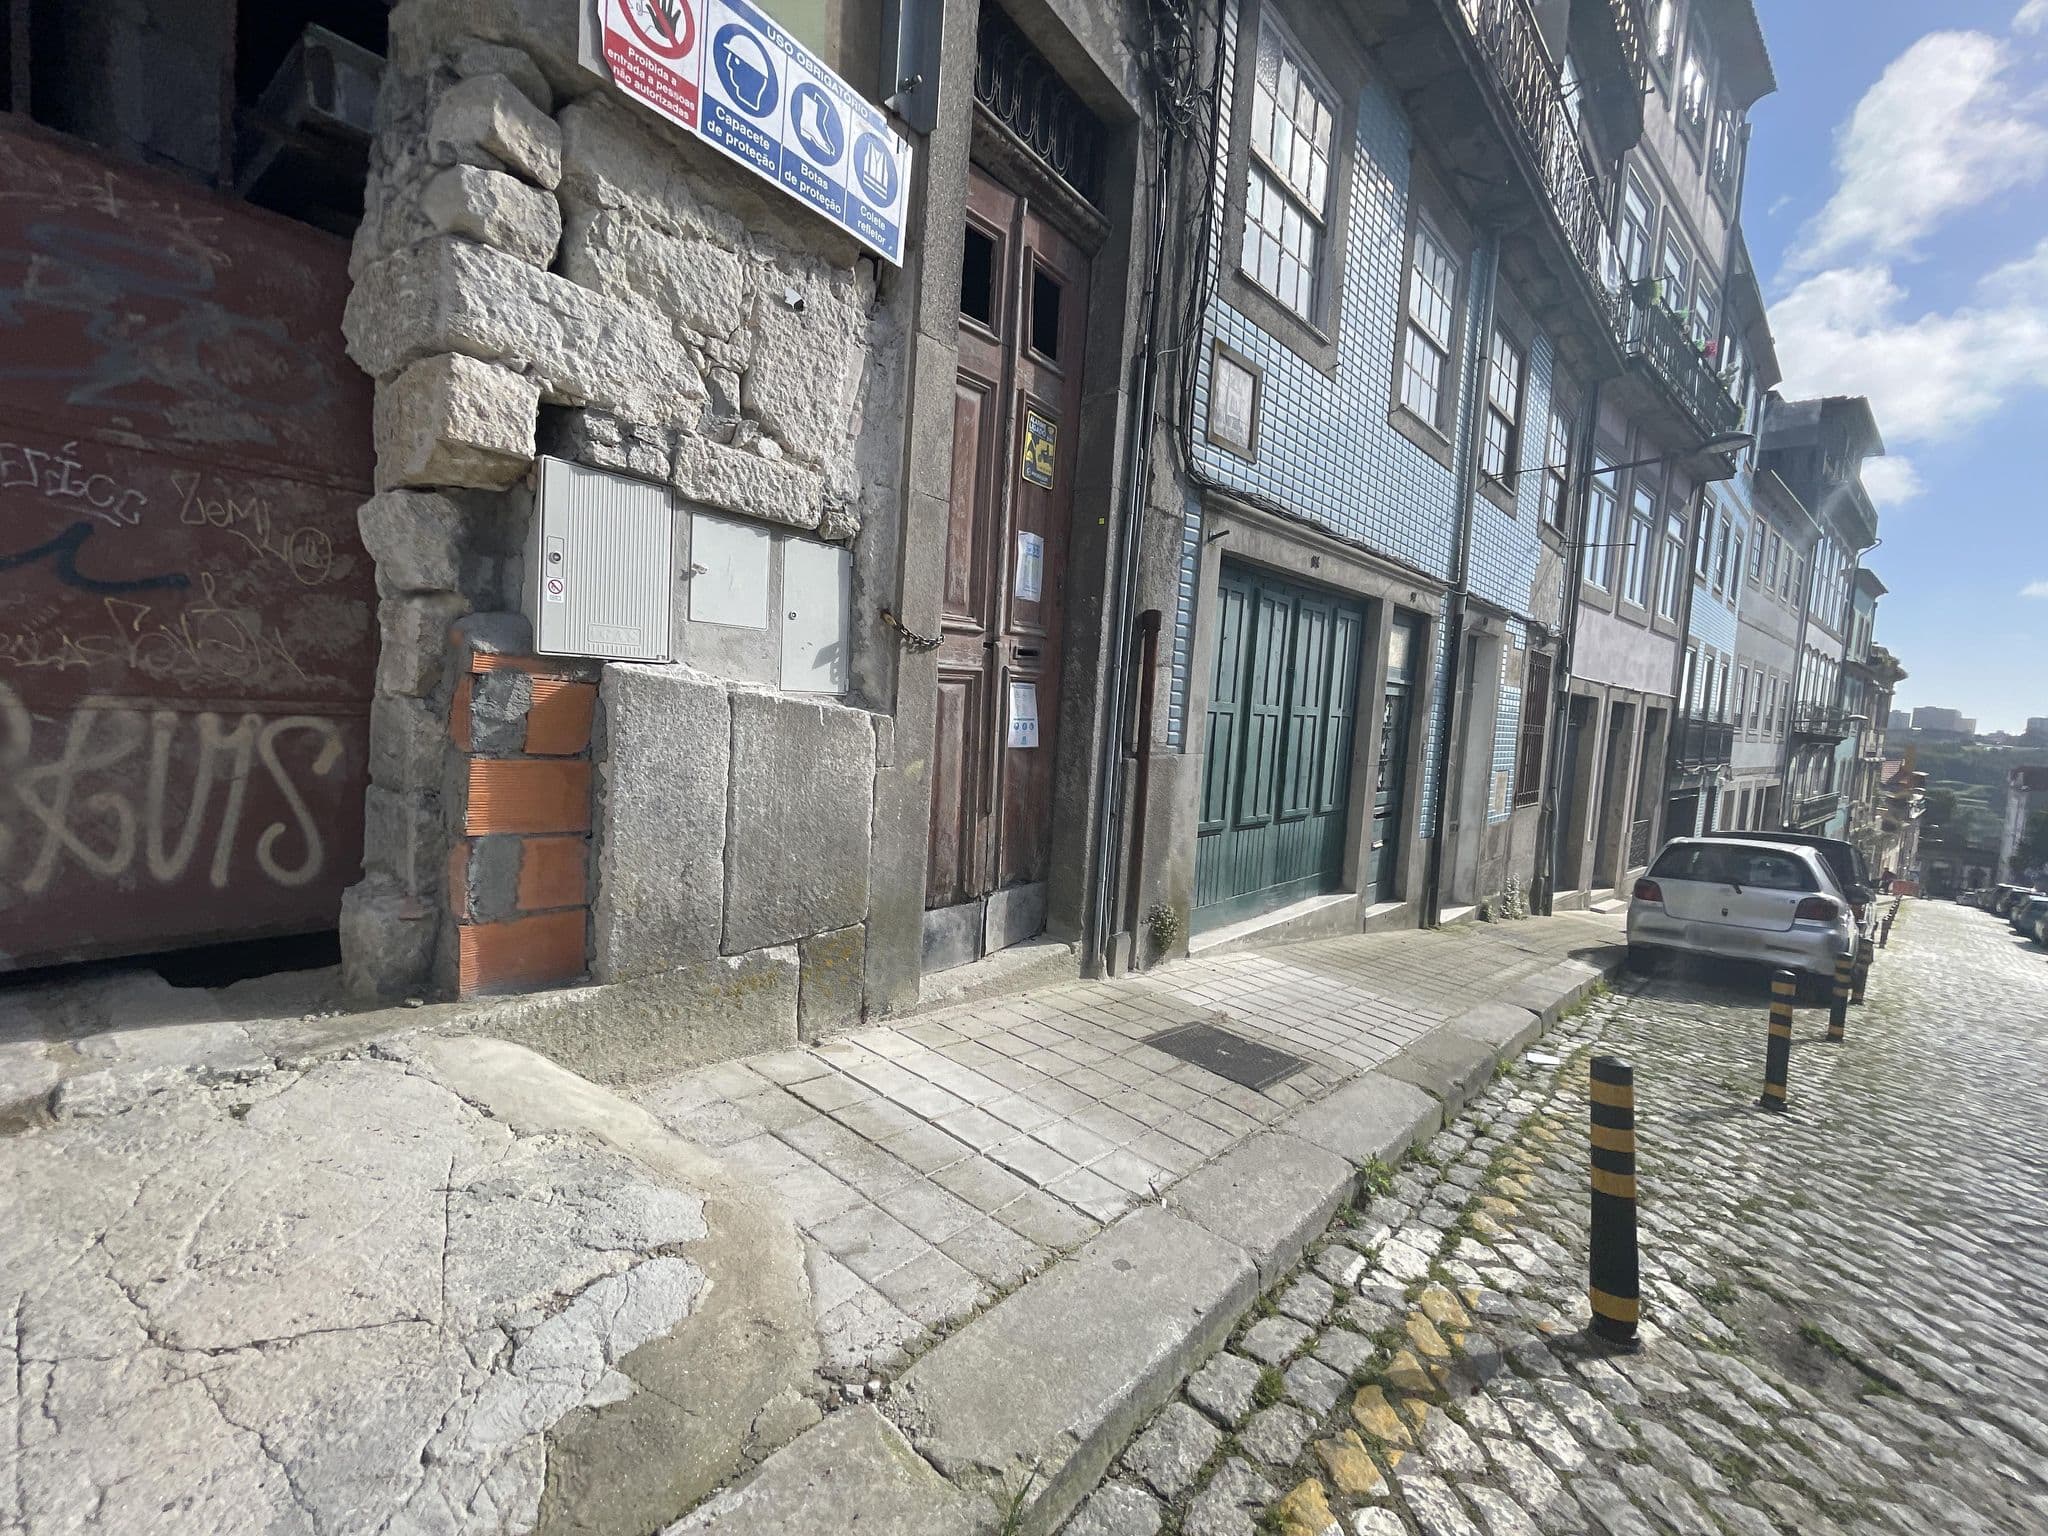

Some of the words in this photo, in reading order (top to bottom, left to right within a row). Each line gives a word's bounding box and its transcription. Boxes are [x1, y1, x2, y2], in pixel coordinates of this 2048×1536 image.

[767, 25, 794, 55] USO
[607, 48, 645, 78] entrada
[647, 75, 654, 84] a
[656, 80, 695, 111] pessoas
[628, 47, 669, 81] Proibida
[670, 77, 677, 86] a
[613, 65, 632, 84] não
[634, 80, 689, 120] autorizadas
[707, 120, 723, 137] de
[725, 132, 776, 171] proteção
[715, 106, 770, 150] Capacete
[784, 170, 798, 186] de
[800, 183, 842, 214] proteção
[800, 163, 829, 190] Botas
[857, 220, 886, 246] refletor
[860, 205, 886, 231] Colete
